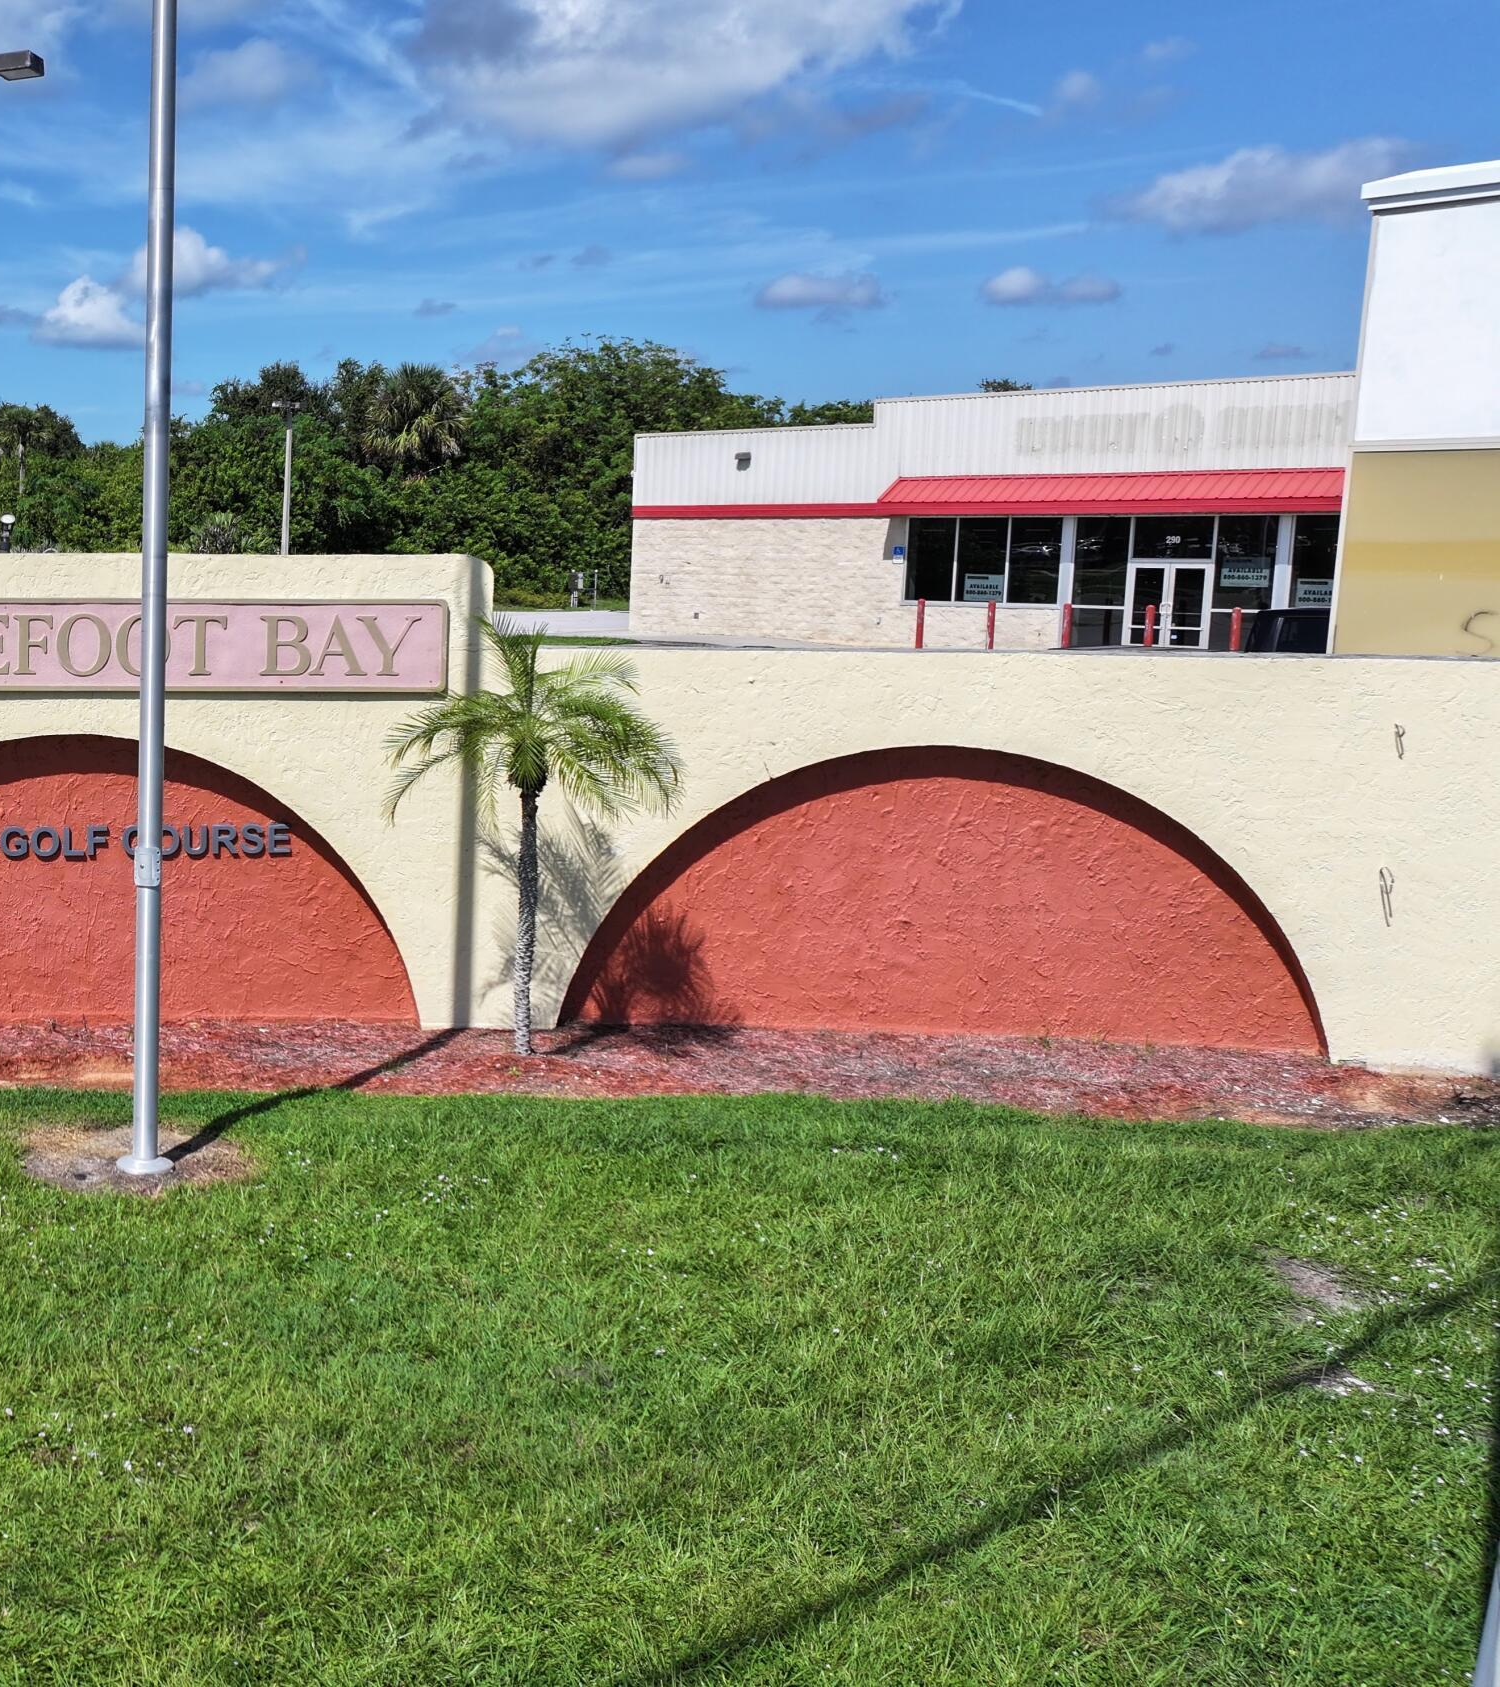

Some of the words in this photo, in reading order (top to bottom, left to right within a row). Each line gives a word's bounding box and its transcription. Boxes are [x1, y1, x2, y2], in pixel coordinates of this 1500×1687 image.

[1165, 535, 1181, 544] 290
[259, 614, 422, 677] BAY
[0, 824, 109, 858] GOLF
